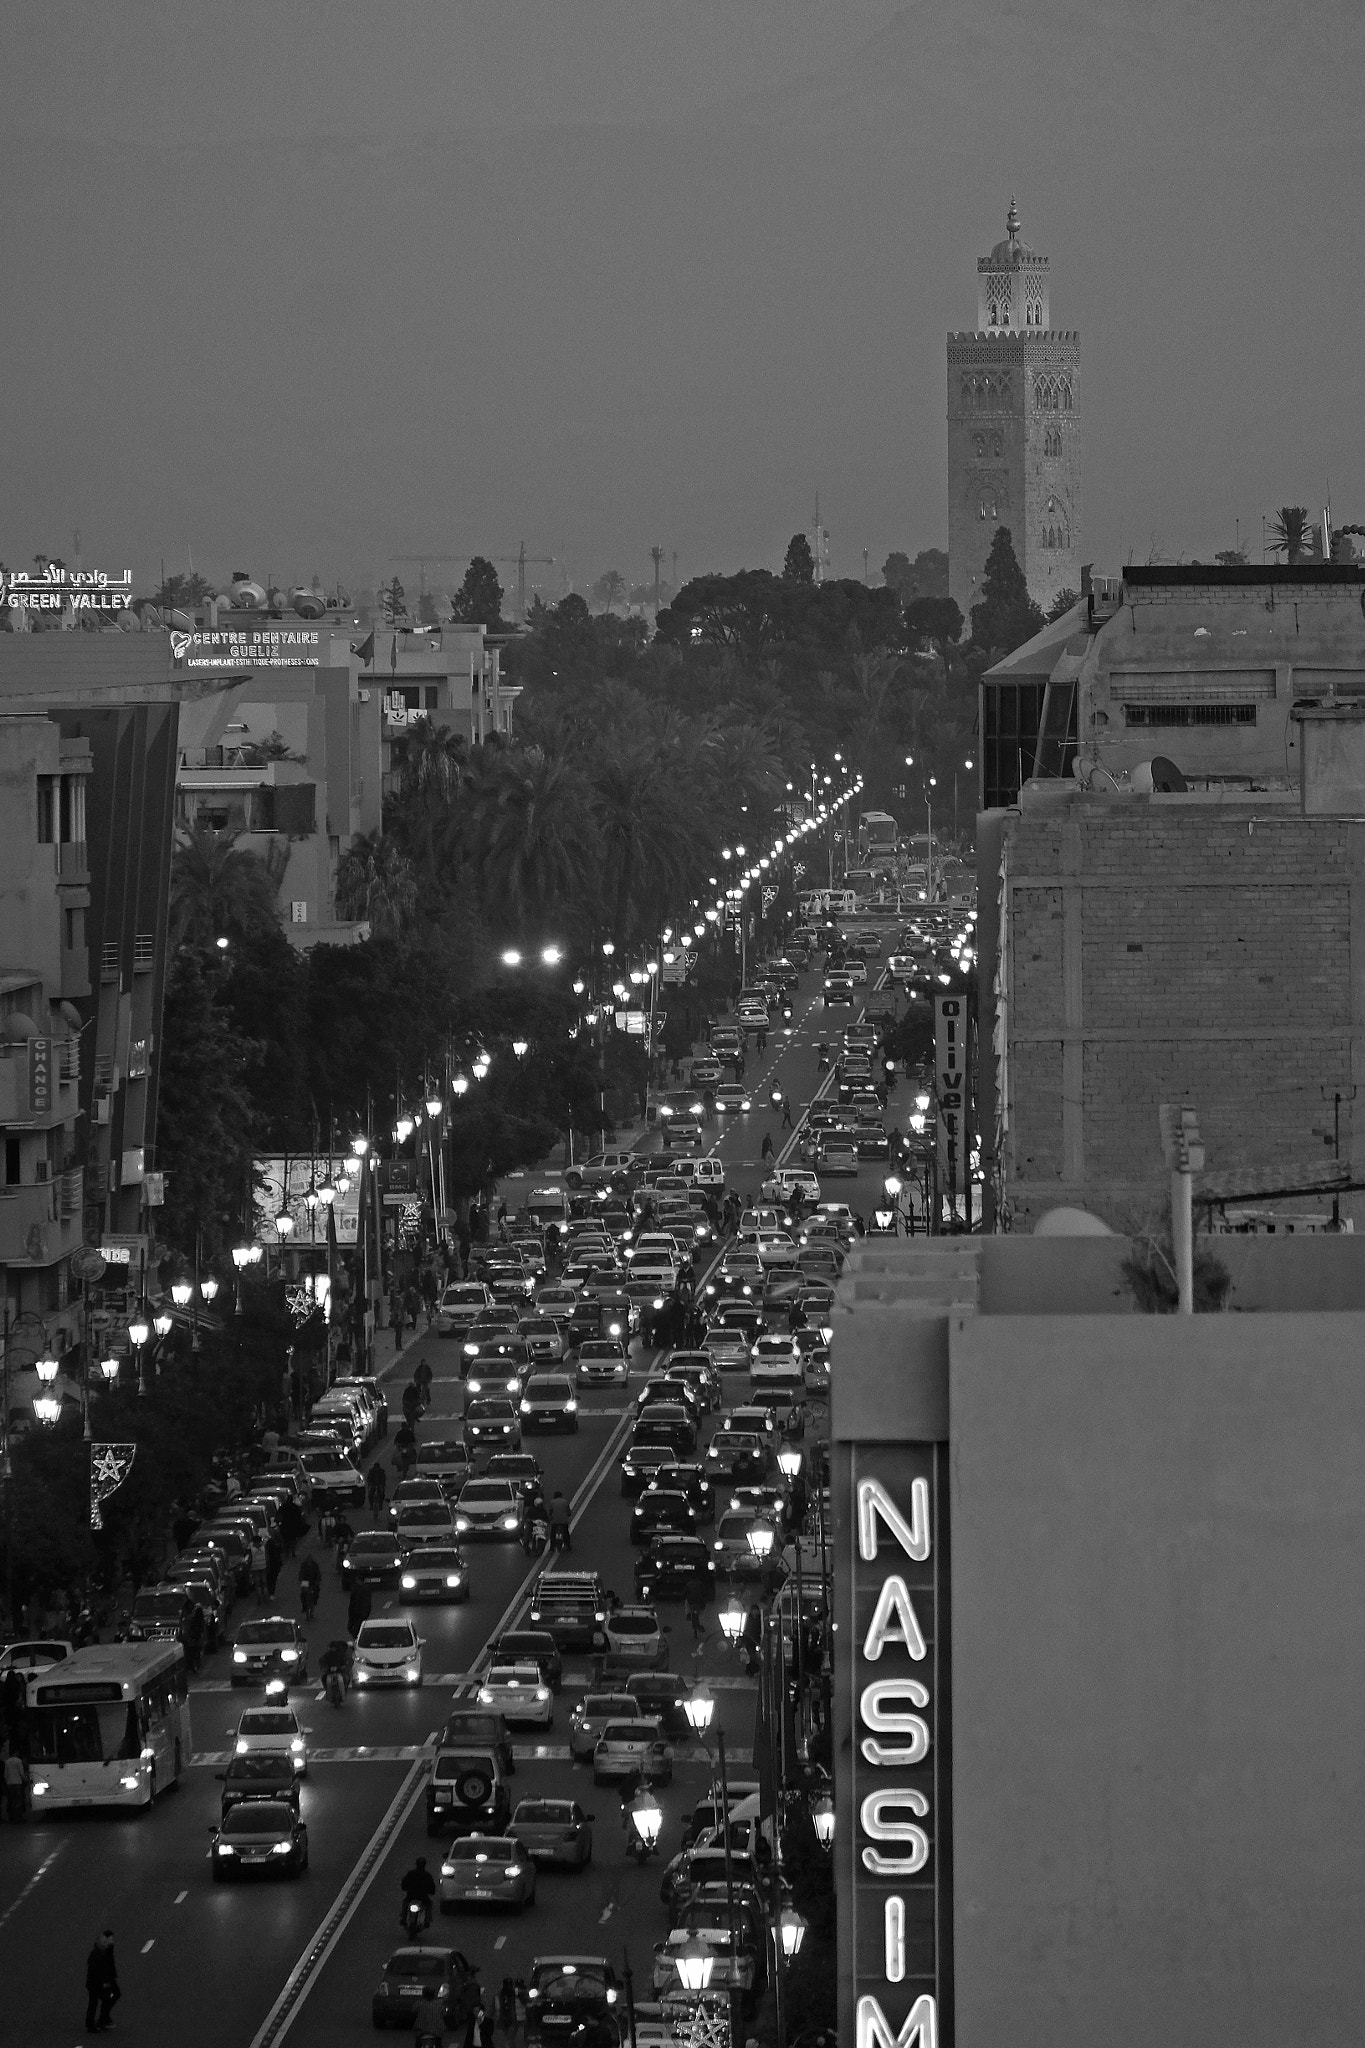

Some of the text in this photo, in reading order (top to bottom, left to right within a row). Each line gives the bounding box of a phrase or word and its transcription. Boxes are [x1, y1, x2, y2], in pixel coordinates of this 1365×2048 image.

[7, 593, 132, 609] GREEN VALLEY
[193, 632, 319, 644] CENTRE DENTAIRE
[230, 645, 279, 657] GUELIZ
[34, 1040, 47, 1107] CHANGE
